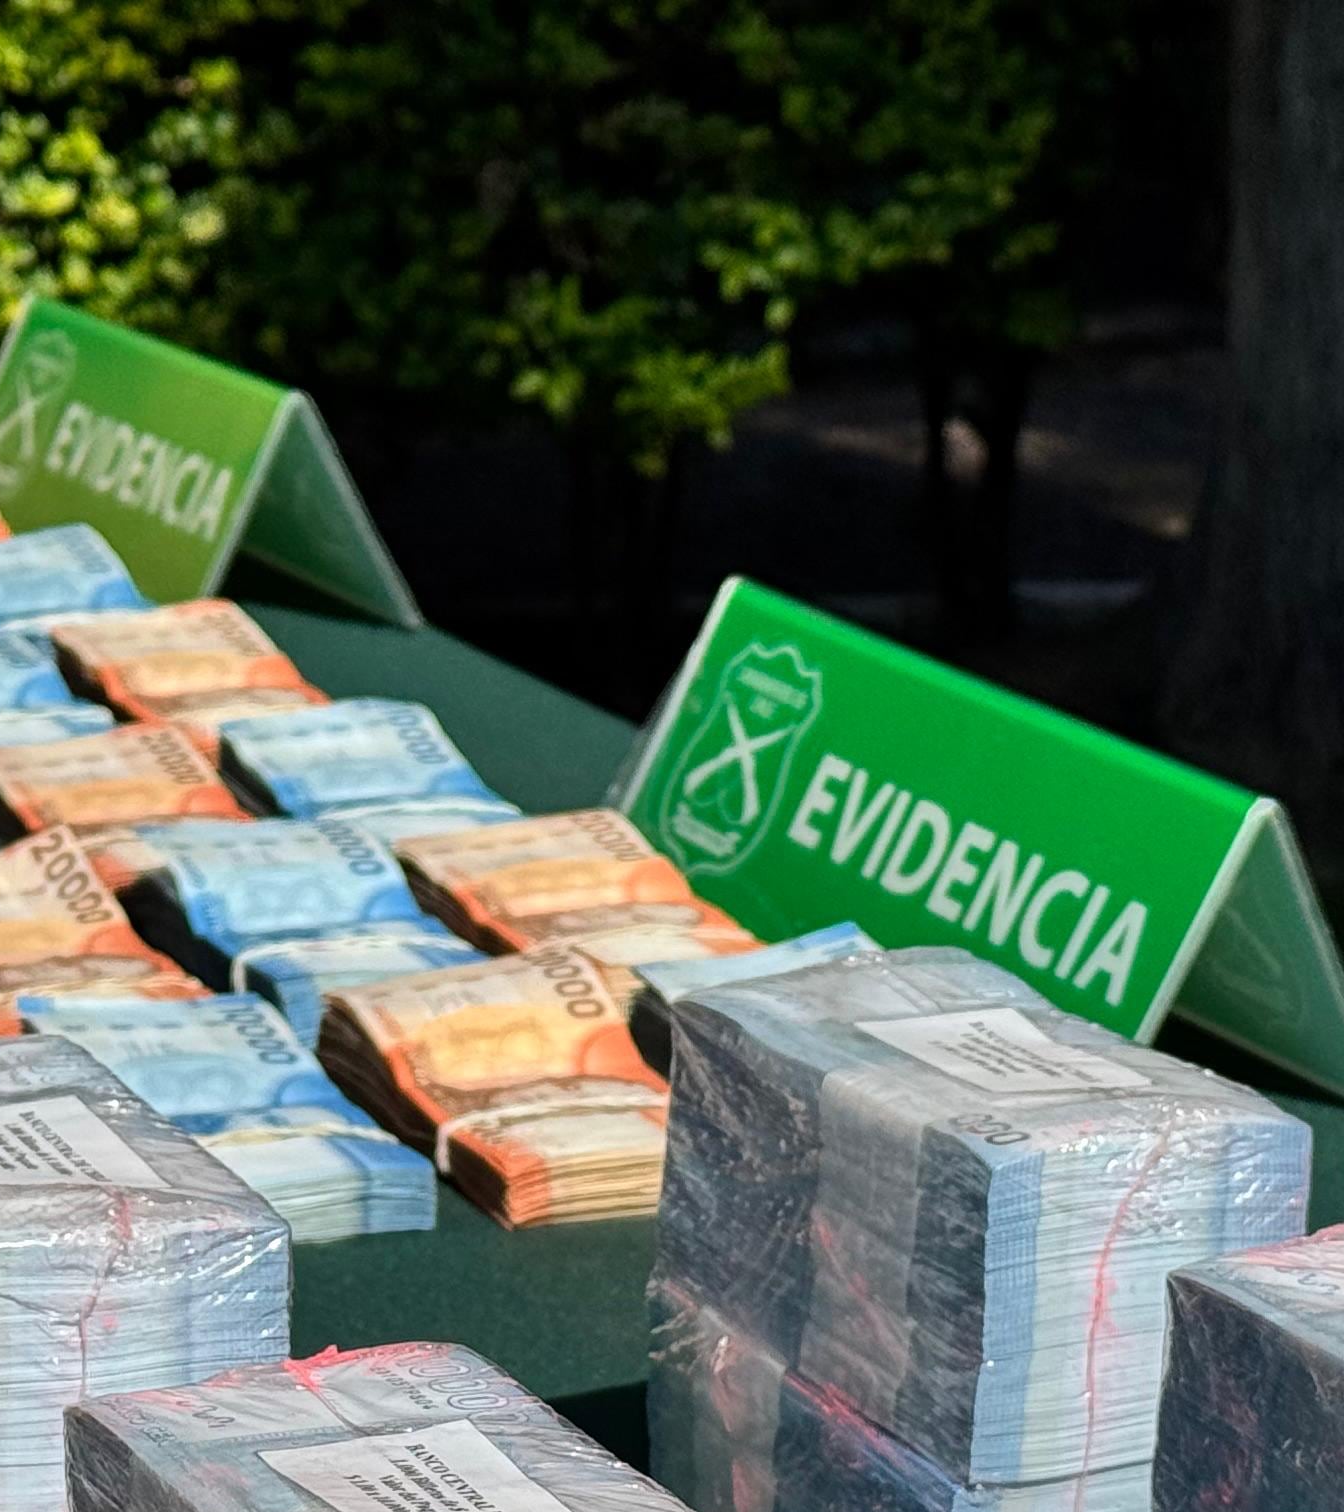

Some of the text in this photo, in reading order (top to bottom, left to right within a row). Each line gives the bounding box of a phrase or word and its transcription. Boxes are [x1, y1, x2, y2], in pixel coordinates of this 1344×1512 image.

[46, 402, 234, 542] EVIDENCIA
[31, 832, 115, 925] 20000
[787, 753, 1149, 1007] EVIDENCIA
[404, 1443, 449, 1474] BANCO
[440, 1472, 495, 1511] CENTRAL
